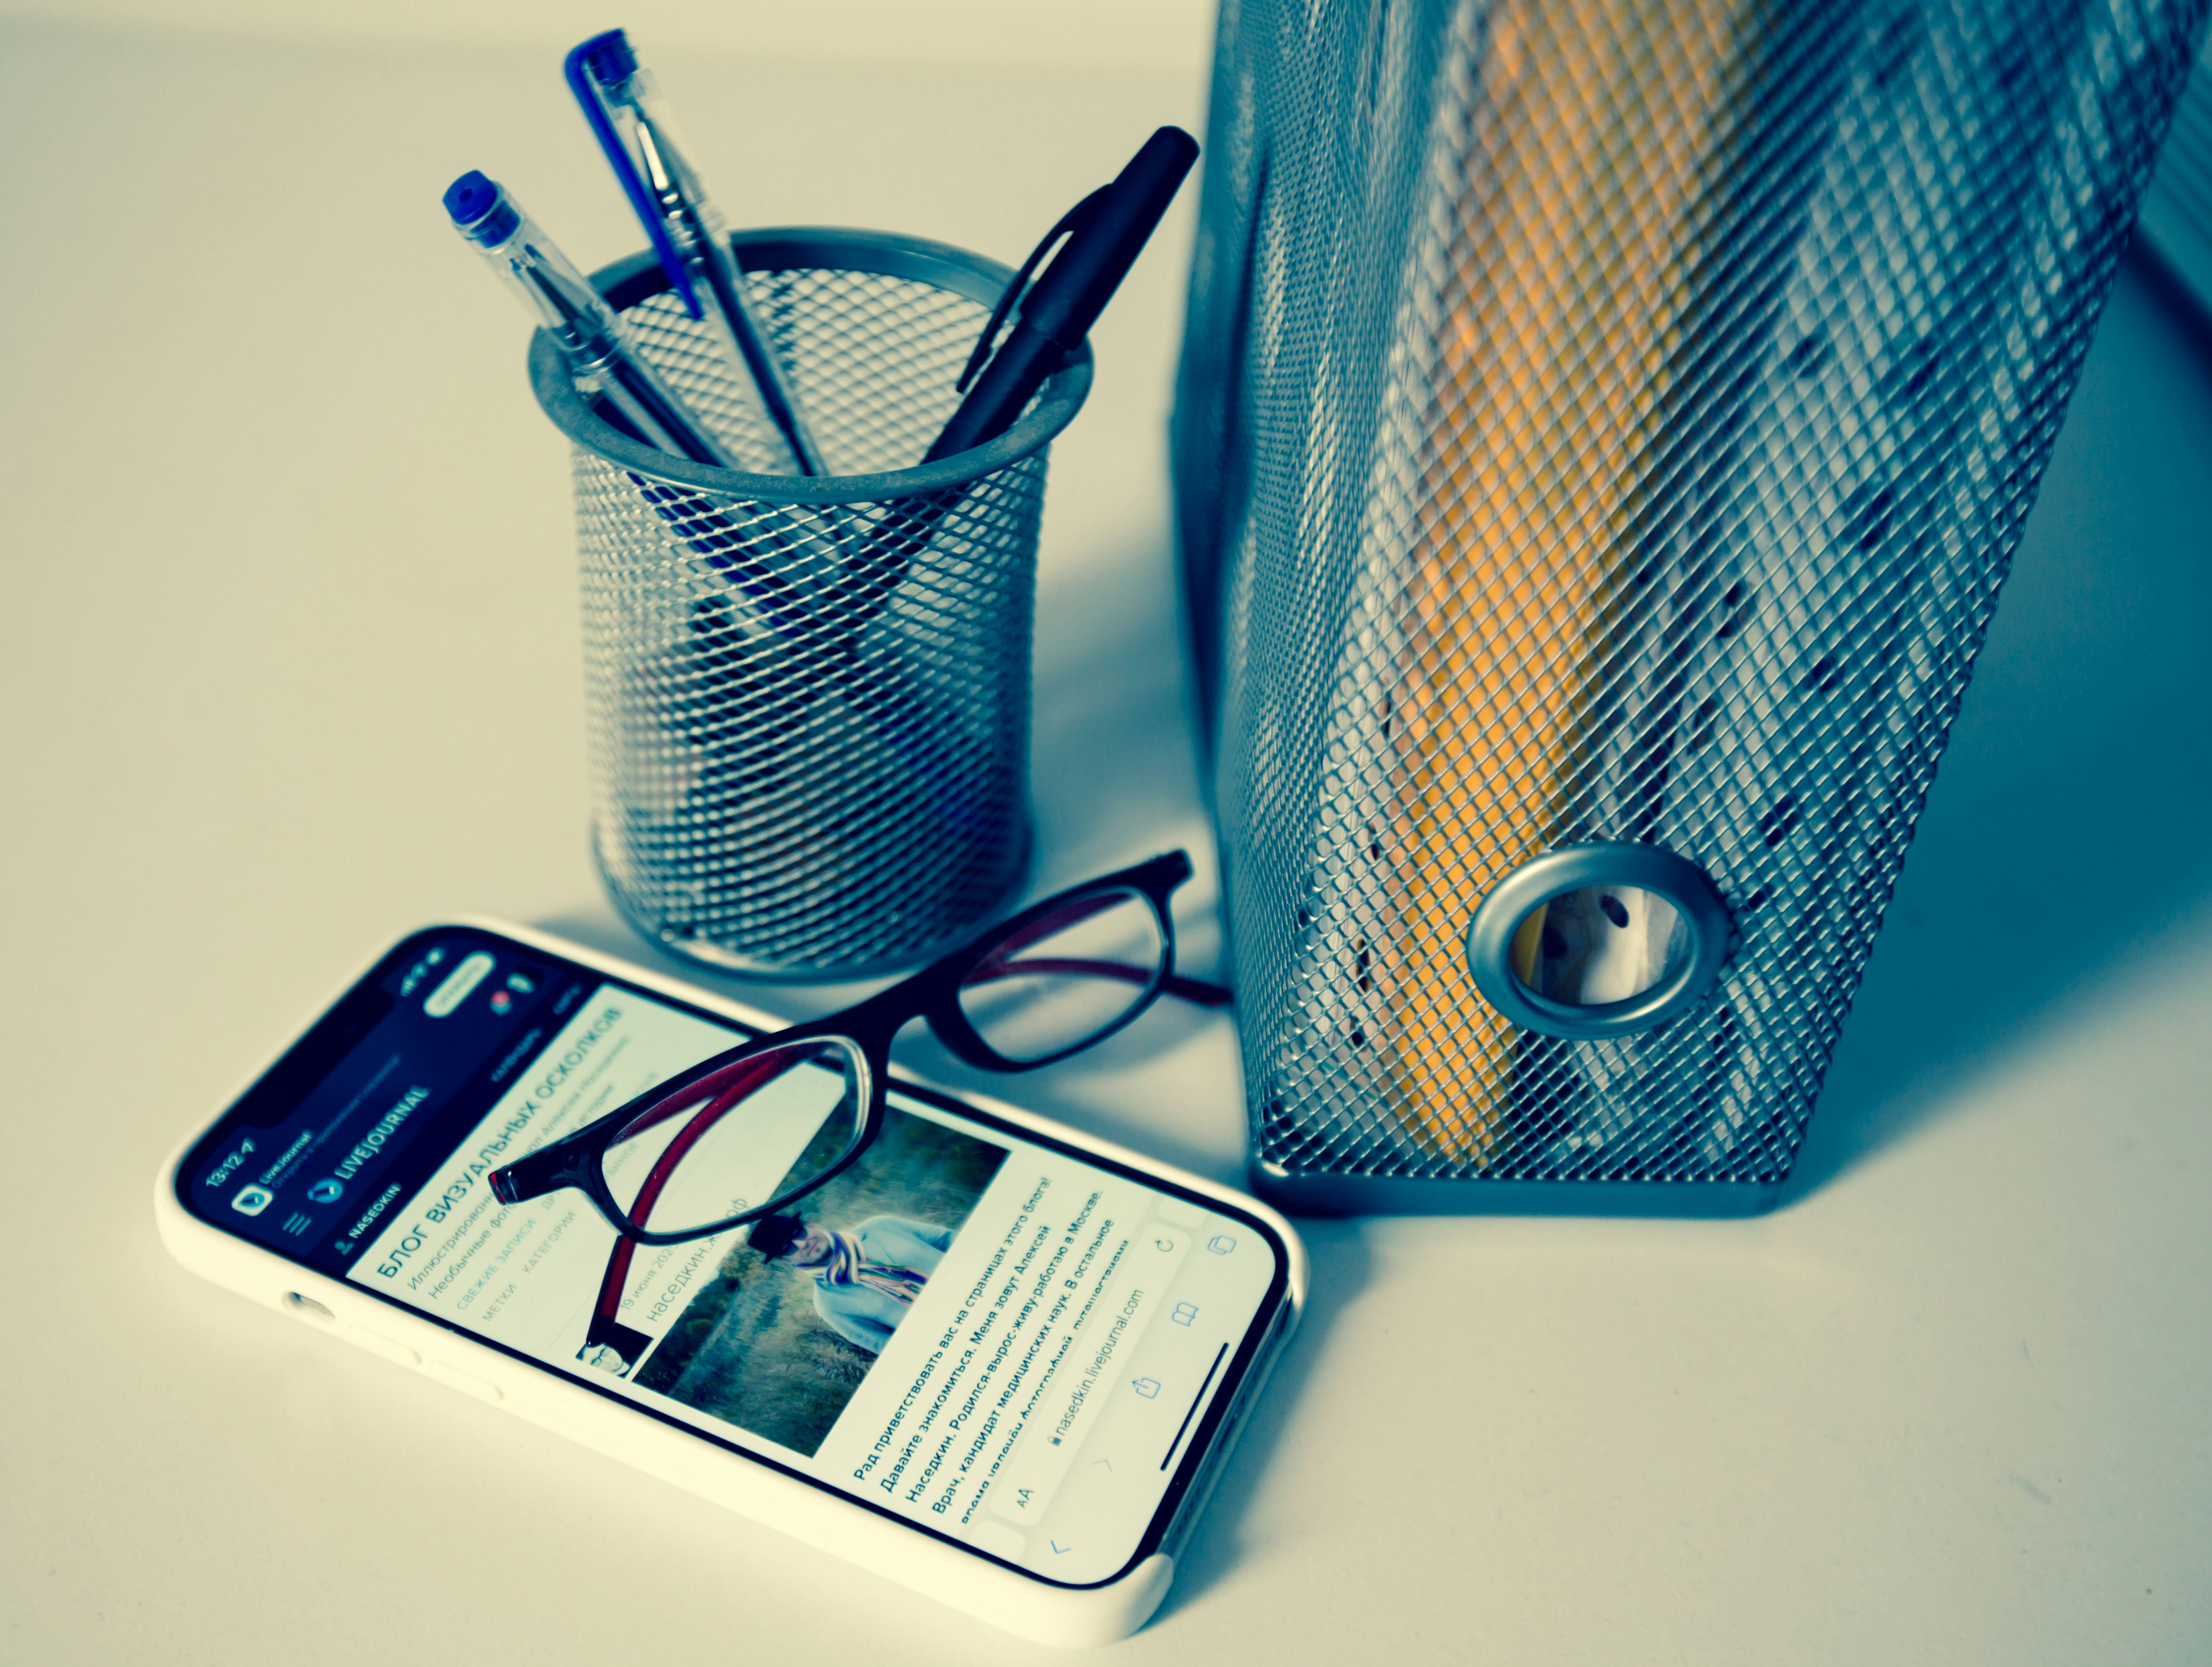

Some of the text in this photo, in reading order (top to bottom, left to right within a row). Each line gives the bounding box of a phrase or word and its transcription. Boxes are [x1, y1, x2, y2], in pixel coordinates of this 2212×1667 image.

[204, 1152, 245, 1188] 13:12
[259, 1132, 311, 1184] LiveJournal
[334, 1090, 427, 1179] LIVEJOURNAL
[377, 1224, 427, 1278] БЛОГ
[425, 1101, 537, 1223] ВИЗУАЛЬНЫХ
[535, 1007, 622, 1098] ОСКОЛКОВ
[348, 1185, 400, 1238] NASEDKIN
[403, 1191, 500, 1292] Иллюстрированн
[646, 1198, 750, 1322] наседкин.жрф
[428, 1230, 491, 1299] Необычные
[457, 1264, 499, 1310] СВЕЖИЕ
[495, 1219, 536, 1263] ЗАПИСИ
[482, 1283, 517, 1321] МЕТКИ
[521, 1211, 577, 1273] КАТЕГОРИИ
[620, 1298, 635, 1310] 19
[632, 1270, 657, 1298] июня
[853, 1177, 1049, 1480] Рад приветствовать вас на страницах этого блога!
[880, 1225, 1051, 1493] Давайте знакомиться. Меня зовут Алексей
[905, 1435, 956, 1502] Наседкин.
[948, 1246, 1068, 1430] Родился-вырос-живу-работаю
[1067, 1188, 1102, 1235] Москве.
[932, 1220, 1114, 1513] Врач, кандидат медицинских наук. В остальное
[1055, 1289, 1144, 1436] nasedkin.livejournal.com
